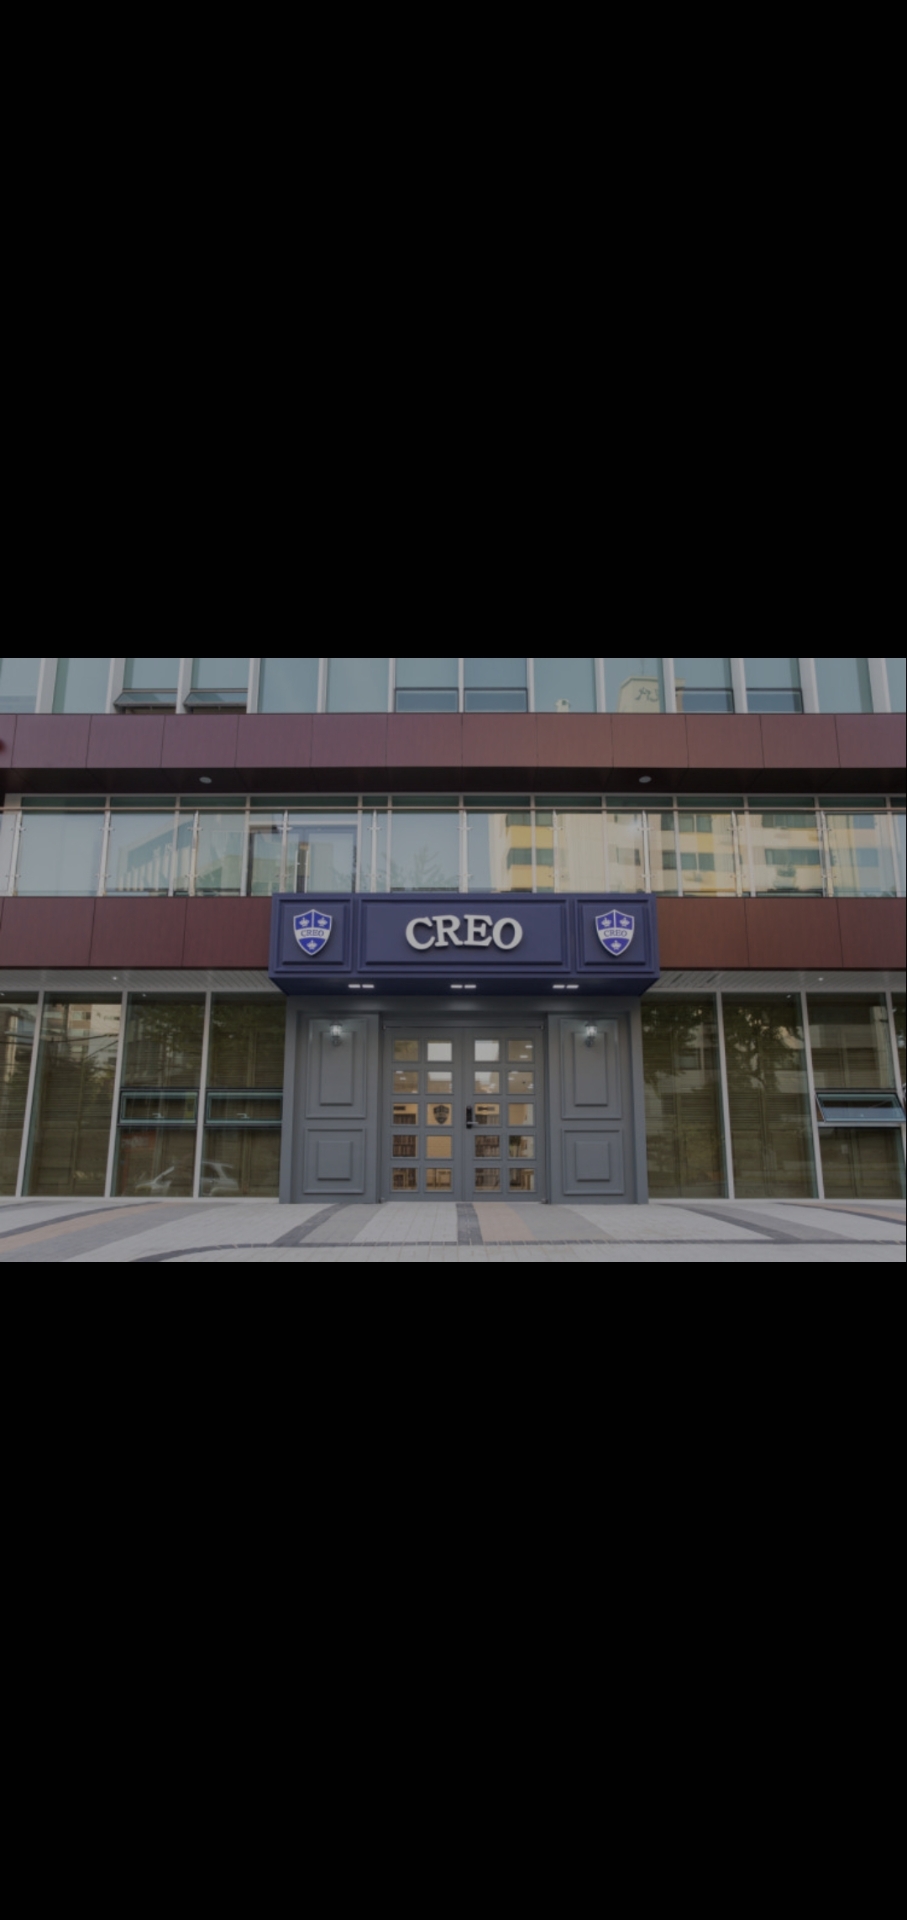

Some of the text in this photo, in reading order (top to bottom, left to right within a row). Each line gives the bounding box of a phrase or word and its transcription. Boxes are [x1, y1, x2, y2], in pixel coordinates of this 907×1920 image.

[300, 929, 325, 938] CREO
[405, 914, 523, 950] CREO
[603, 929, 628, 938] CREO
